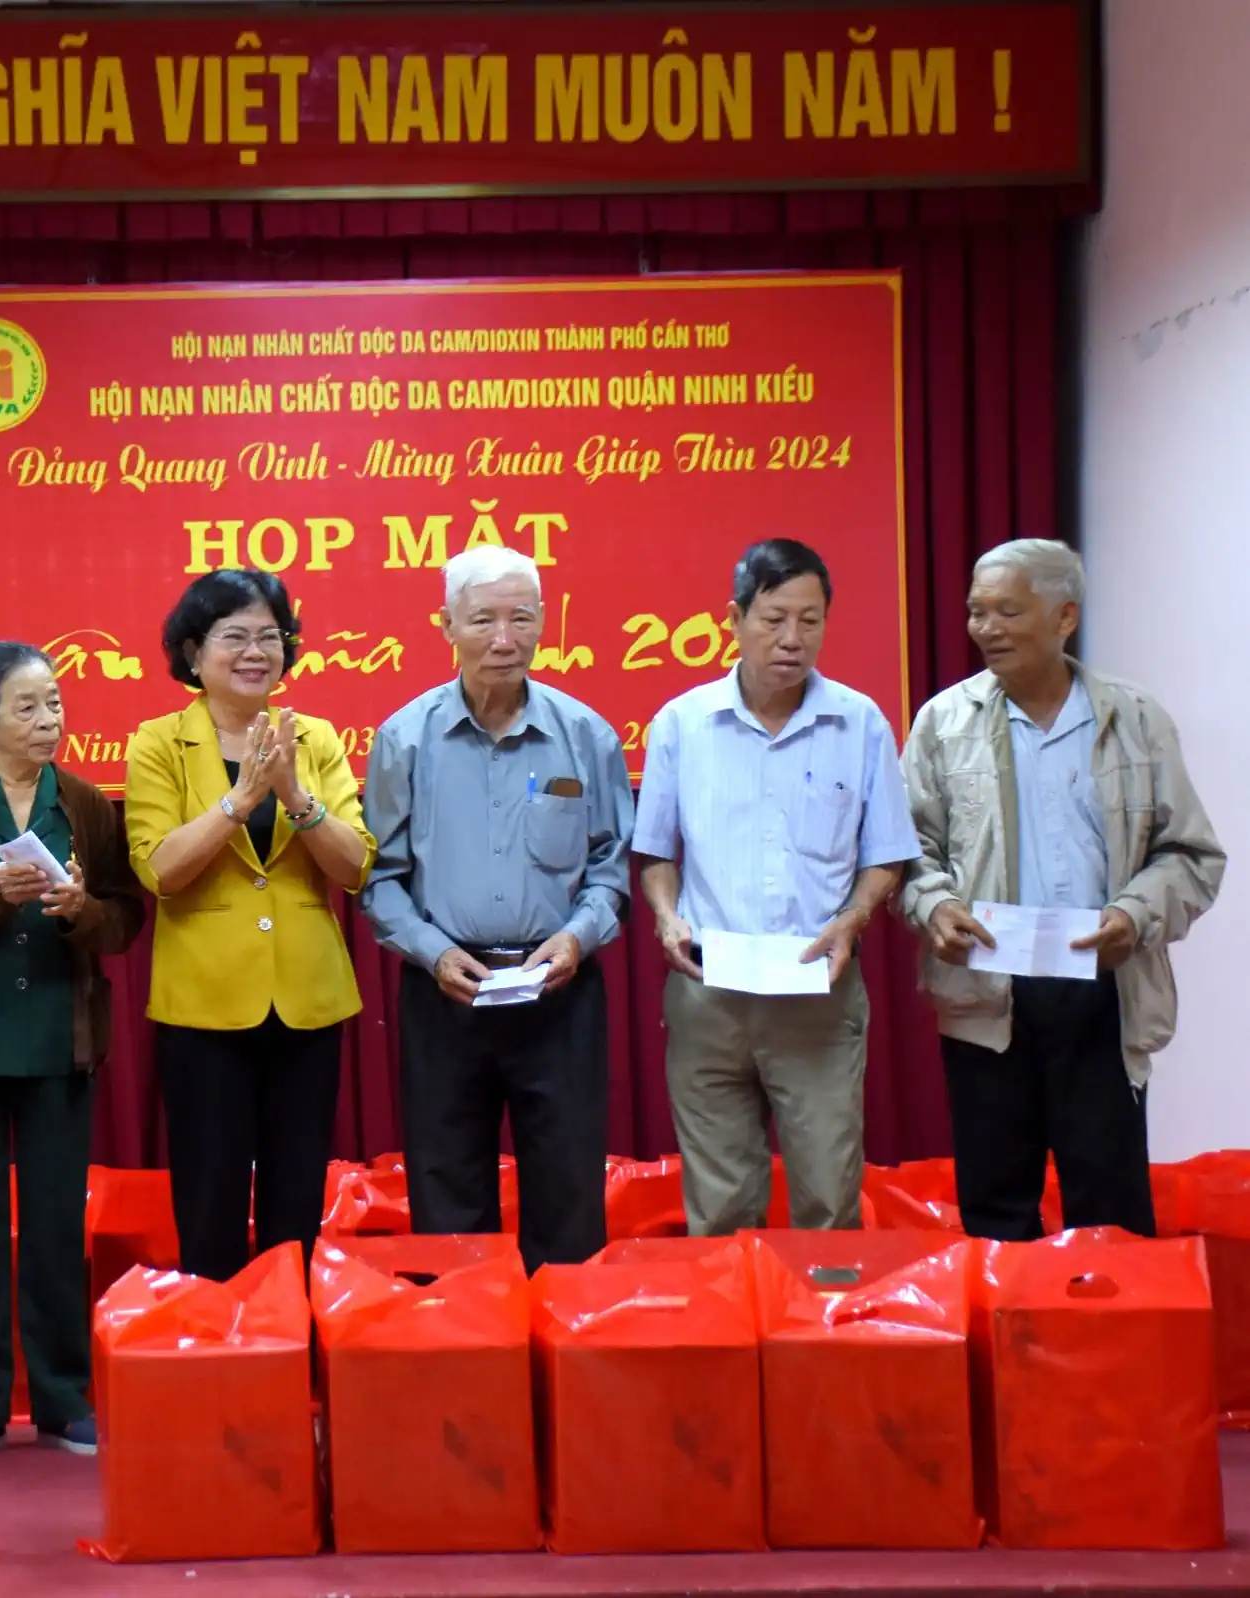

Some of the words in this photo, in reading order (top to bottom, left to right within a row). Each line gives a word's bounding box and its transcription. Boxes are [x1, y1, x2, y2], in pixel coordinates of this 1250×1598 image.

[156, 32, 309, 165] VIỆT
[338, 54, 508, 144] NAM
[535, 28, 753, 143] MUÔN
[783, 27, 957, 139] NĂM
[992, 50, 1012, 132] !
[171, 331, 202, 364] HỘI
[208, 335, 247, 362] NẠN
[252, 330, 303, 356] NHÂN
[309, 325, 354, 355] CHẤT
[401, 330, 426, 354] DA
[430, 328, 540, 353] CAM/DIOXIN
[545, 324, 605, 351] THÀNH
[610, 318, 648, 349] PHỐ
[694, 320, 730, 348] THƠ
[89, 380, 132, 422] HỘI
[140, 385, 194, 422] NẠN
[201, 378, 273, 416] NHÂN
[280, 373, 343, 413] CHẤT
[349, 375, 400, 417] ĐỘC
[407, 380, 442, 411] DA
[448, 377, 600, 411] CAM/DIOXIN
[607, 369, 676, 412] QUẬN
[683, 374, 748, 406] NINH
[8, 446, 109, 494] Đảng
[119, 443, 228, 493] Quang
[238, 440, 331, 481] Vinh
[355, 436, 457, 486] Mừng
[466, 436, 564, 478] Xuân
[573, 434, 663, 484] Giáp
[674, 432, 757, 475] Thìn
[765, 434, 853, 471] 2024
